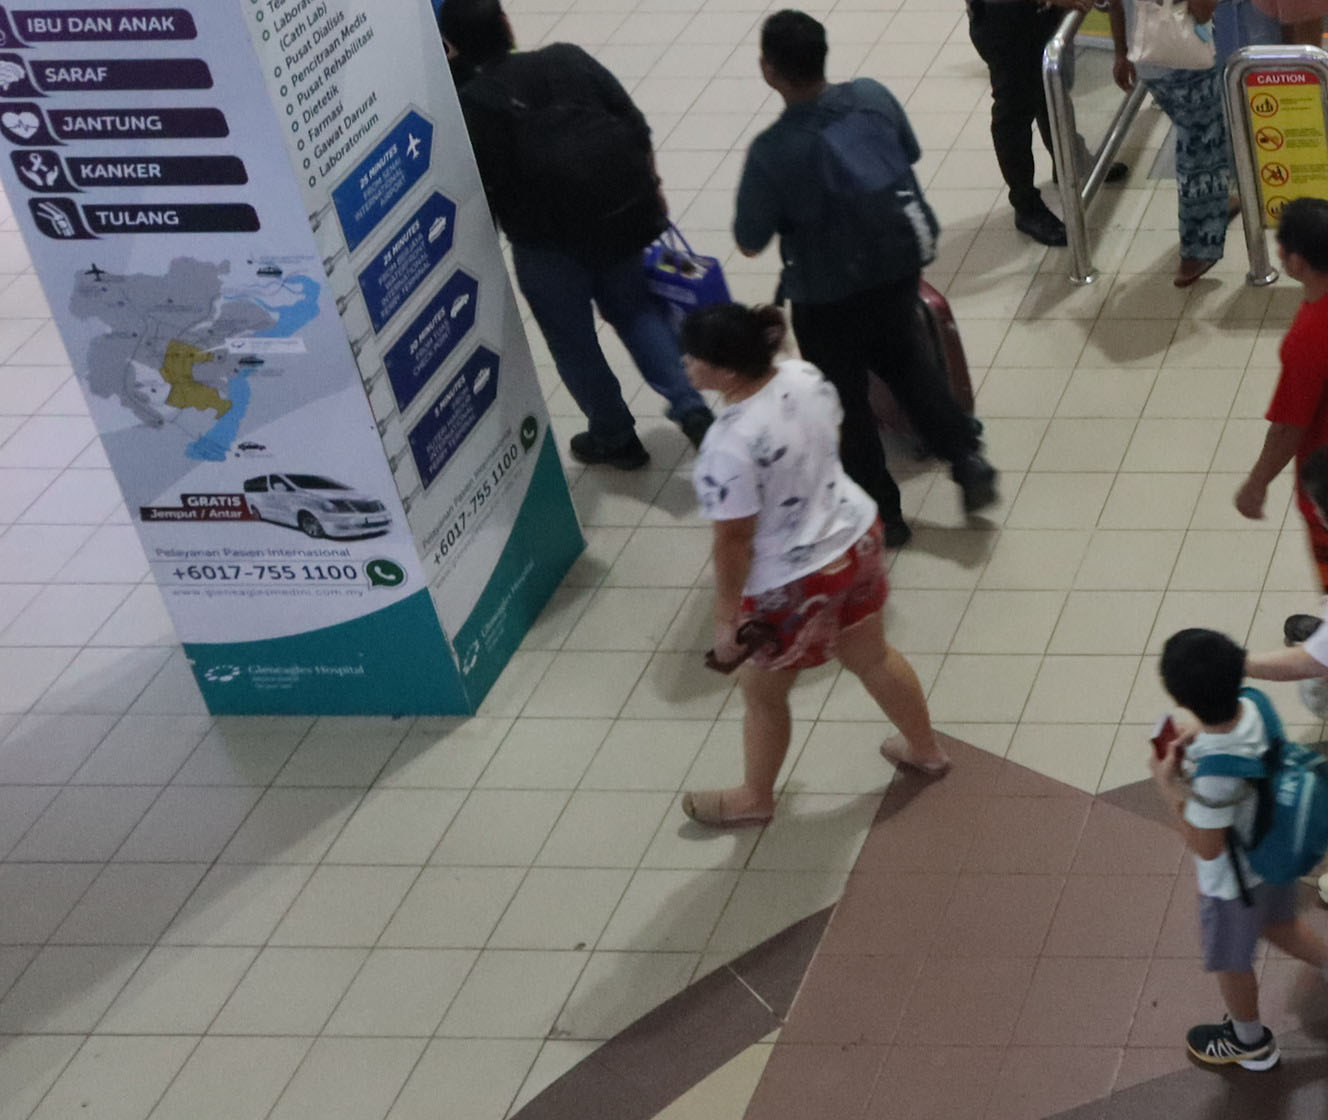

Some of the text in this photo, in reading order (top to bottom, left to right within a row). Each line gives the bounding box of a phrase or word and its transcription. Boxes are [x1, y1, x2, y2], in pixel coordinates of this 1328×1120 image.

[27, 16, 175, 33] IBU DAN ANAK
[279, 22, 307, 52] (Cath
[285, 11, 346, 70] Pusat Dialisis
[291, 12, 368, 87] Pencitraan Medis
[45, 67, 108, 83] SARAF
[297, 28, 375, 106] Pusat Rehabilitasi
[1256, 74, 1306, 84] CAUTION
[302, 85, 340, 124] Dietetik
[62, 116, 162, 132] JANTUNG
[308, 103, 345, 141] Farmasi
[313, 92, 378, 160] Gawat Darurat
[319, 113, 380, 177] Laboratorium
[80, 164, 162, 178] KANKER
[96, 211, 179, 225] TULANG
[492, 444, 518, 485] 1100
[187, 496, 241, 507] GRATIS
[150, 508, 243, 519] Jemput Antar
[173, 565, 357, 580] +6017-755 1100
